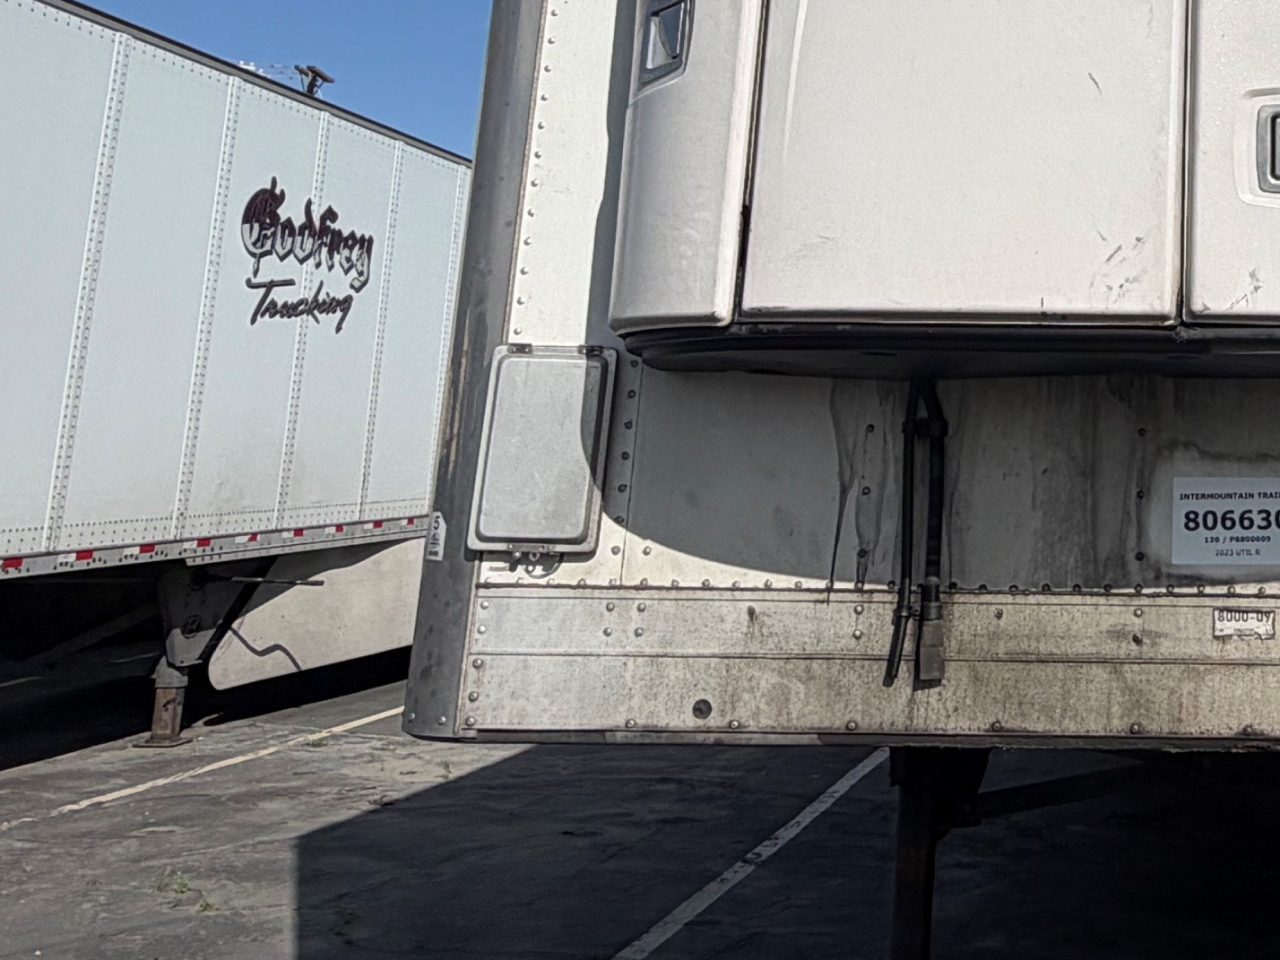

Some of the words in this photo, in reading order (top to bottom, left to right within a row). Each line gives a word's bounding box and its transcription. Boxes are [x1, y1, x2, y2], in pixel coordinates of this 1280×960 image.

[241, 175, 374, 293] Godfrey
[245, 277, 354, 335] Trucking
[1179, 492, 1255, 501] INTERMOUNTAIN
